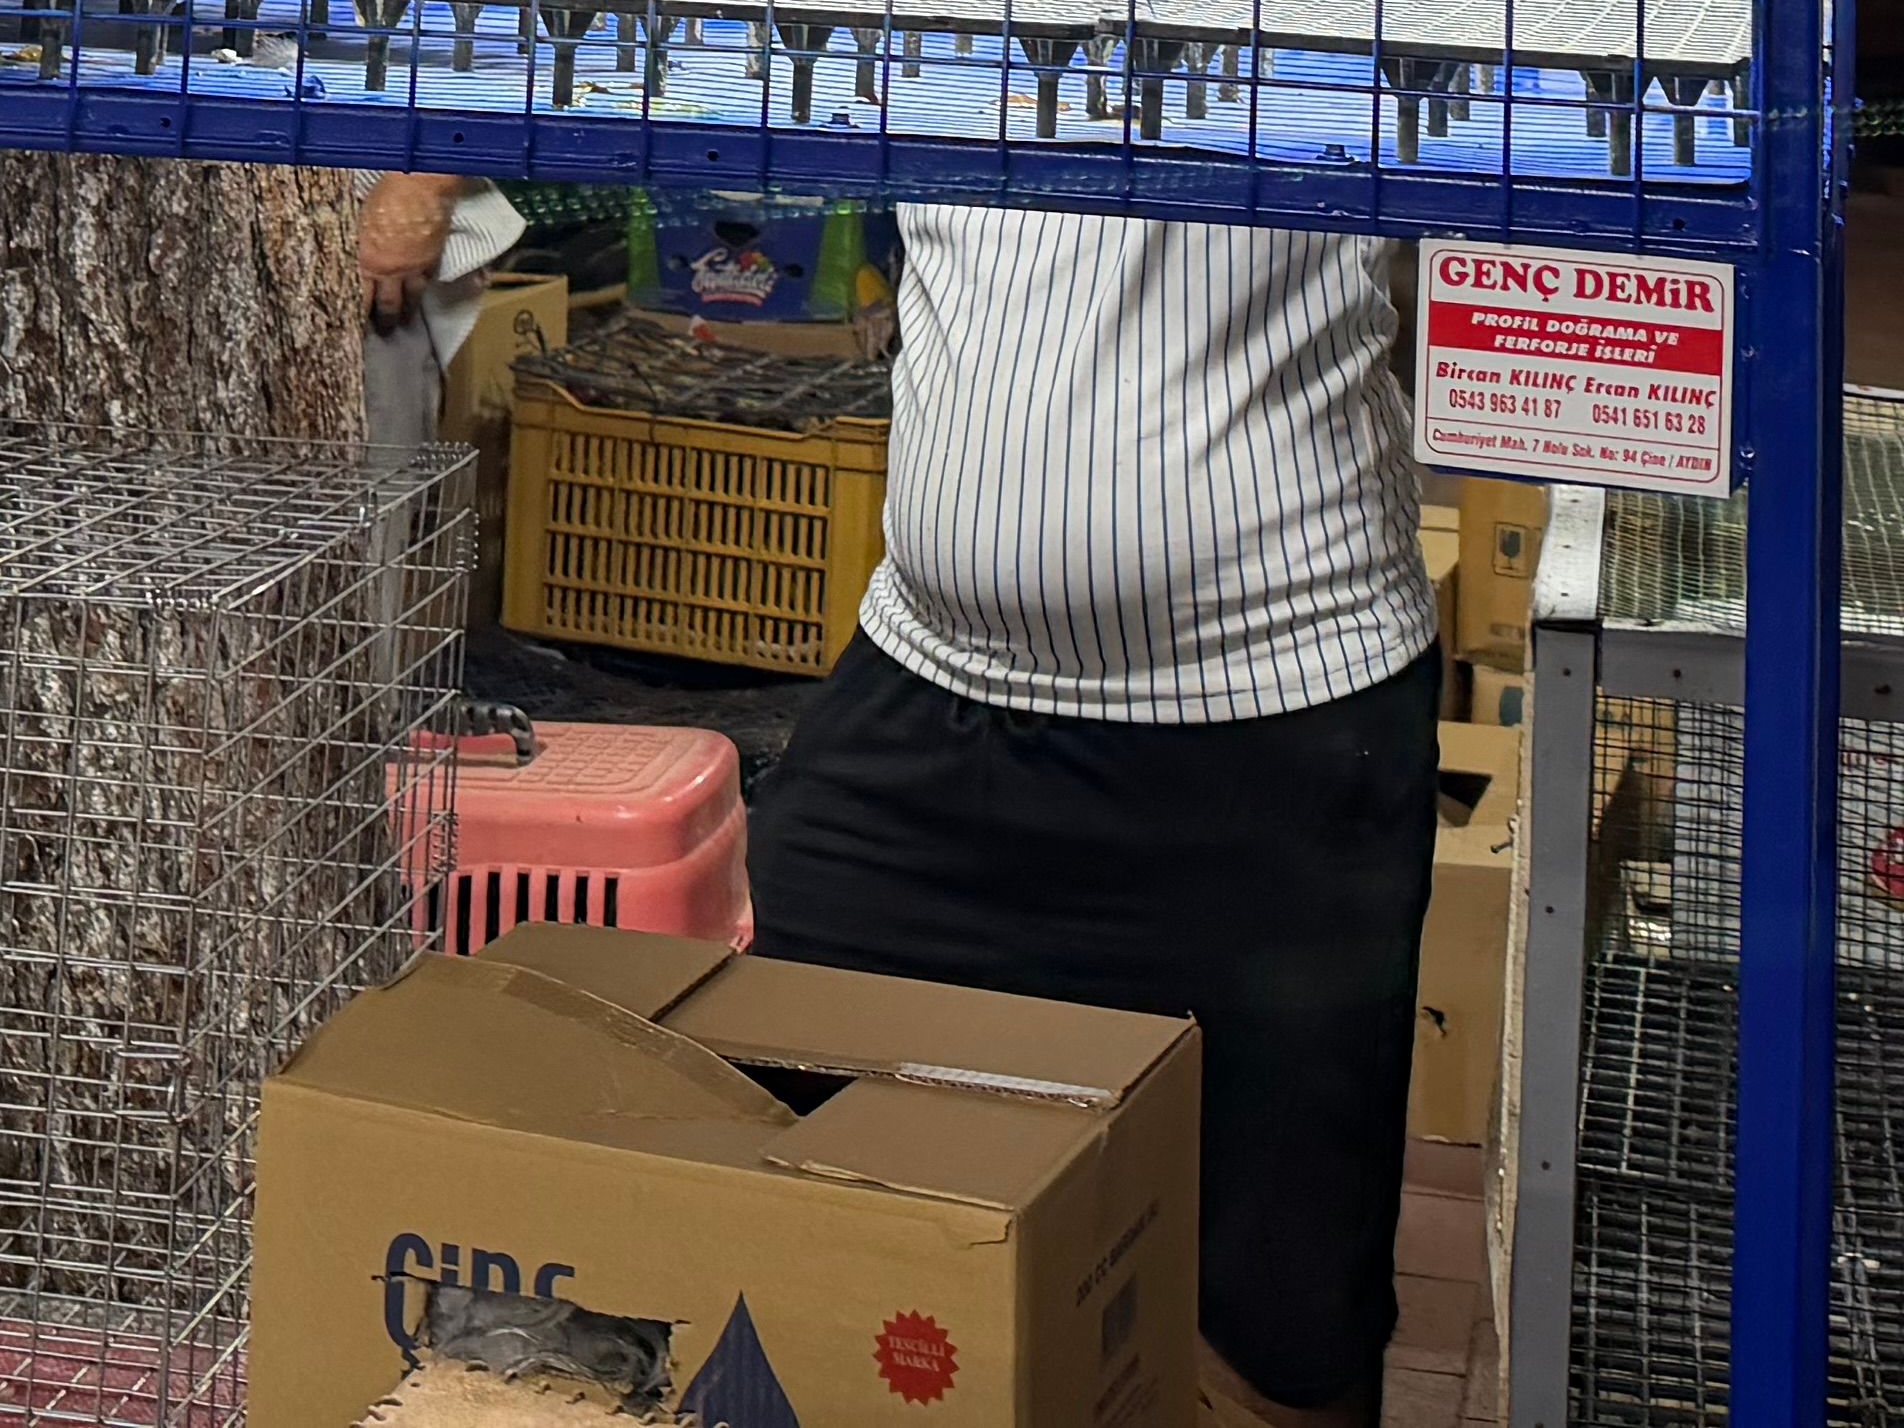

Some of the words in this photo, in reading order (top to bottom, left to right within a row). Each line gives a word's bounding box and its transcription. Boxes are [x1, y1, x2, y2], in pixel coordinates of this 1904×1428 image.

[1439, 256, 1561, 303] GENÇ
[1494, 334, 1590, 357] FERFORJE
[1546, 318, 1647, 343] DOĞRAMA
[1653, 330, 1680, 346] VE
[1435, 361, 1501, 384] Bircan
[1508, 368, 1577, 394] KILINÇ
[1584, 376, 1640, 399] Ercan
[1647, 383, 1717, 409] KILINÇ
[1449, 388, 1485, 411] 0543
[1489, 392, 1517, 415] 963
[1521, 396, 1538, 417] 41
[1544, 398, 1562, 419] 87
[1592, 403, 1627, 427] 0541
[1632, 408, 1659, 430] 651
[1665, 410, 1683, 433] 63
[1687, 413, 1706, 435] 28
[1432, 427, 1498, 450] Cumhuriyet
[1500, 434, 1528, 451] Mah.
[1532, 439, 1540, 452] 7
[1622, 448, 1638, 464] 94
[892, 1351, 941, 1373] MARKA
